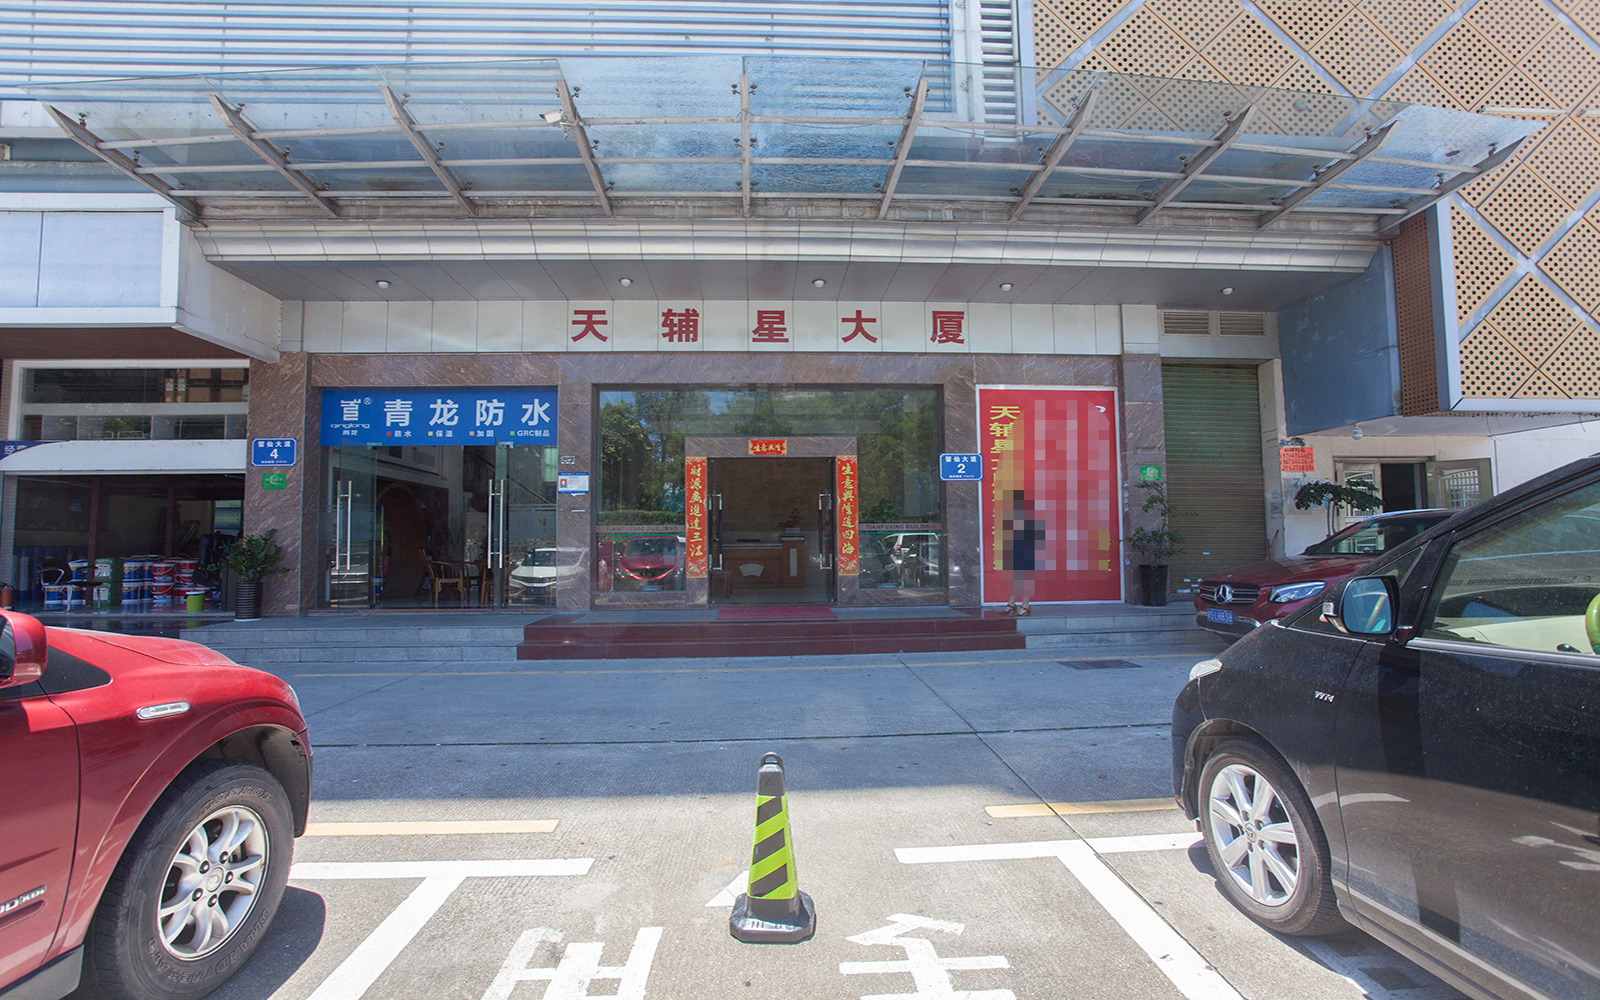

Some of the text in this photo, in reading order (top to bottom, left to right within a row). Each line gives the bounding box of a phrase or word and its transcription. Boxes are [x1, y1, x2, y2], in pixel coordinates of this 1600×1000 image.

[571, 308, 965, 344] 天辅星大厦
[383, 398, 551, 427] 青龙防水
[270, 448, 279, 459] 4
[957, 463, 966, 473] 2
